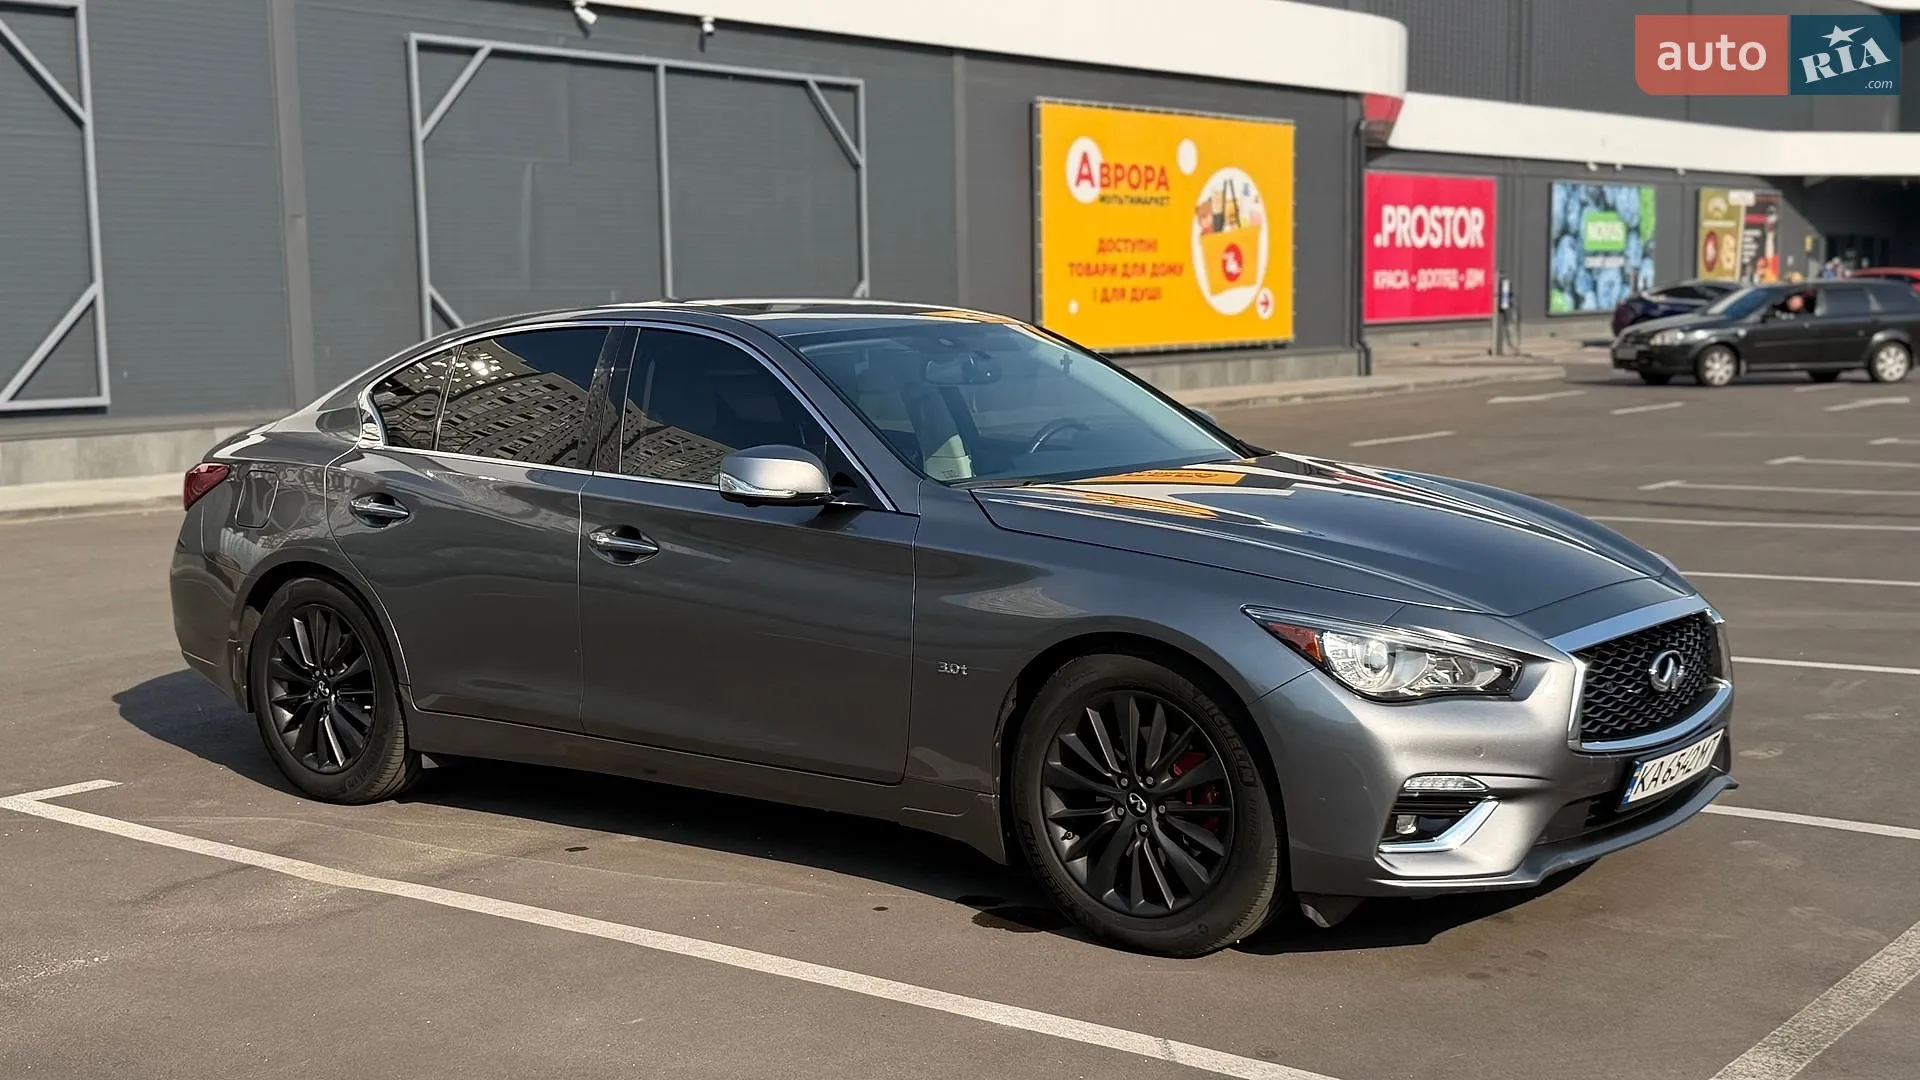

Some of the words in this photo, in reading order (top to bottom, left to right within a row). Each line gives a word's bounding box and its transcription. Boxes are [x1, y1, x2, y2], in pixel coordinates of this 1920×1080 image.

[1074, 151, 1170, 192] АВРОРА
[1373, 204, 1485, 249] .PROSTOR
[1068, 262, 1117, 277] ТОВАРИ
[1121, 262, 1146, 279] ДЛЯ
[1150, 262, 1185, 279] ДОМУ
[1100, 287, 1126, 304] ДЛЯ
